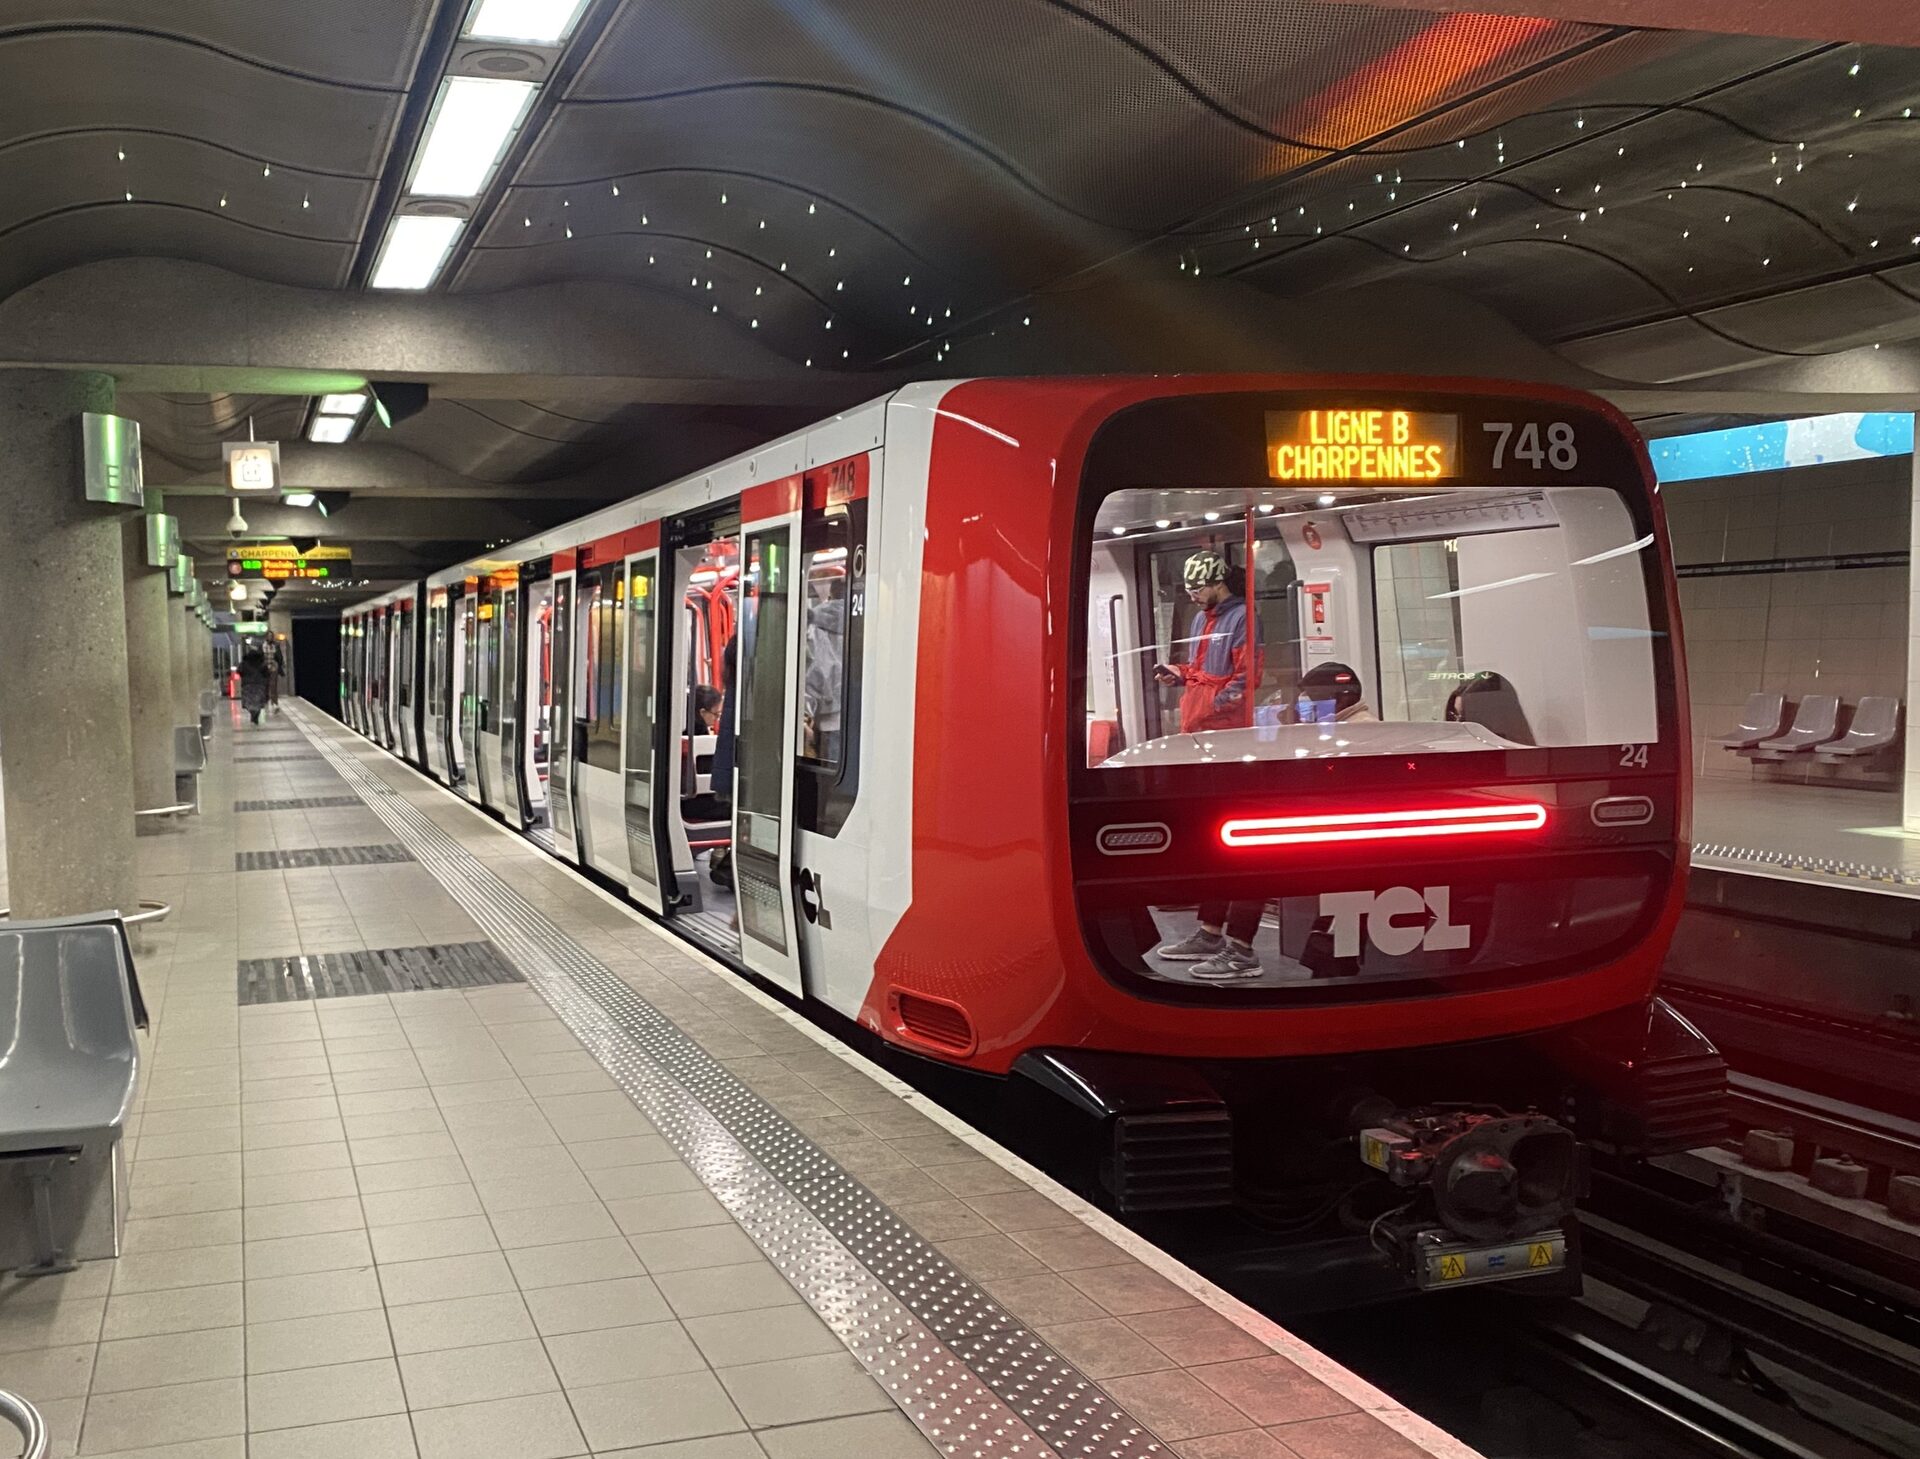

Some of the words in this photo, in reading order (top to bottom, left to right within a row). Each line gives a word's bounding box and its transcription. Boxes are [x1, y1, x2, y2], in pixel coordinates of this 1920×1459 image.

[1310, 411, 1383, 445] LIGNE
[1393, 411, 1410, 445] B
[1278, 445, 1442, 479] CHARPENNES
[1483, 422, 1578, 471] 748
[831, 461, 856, 496] 748
[851, 594, 864, 617] 24
[1619, 744, 1649, 769] 24
[1319, 885, 1471, 958] TCL
